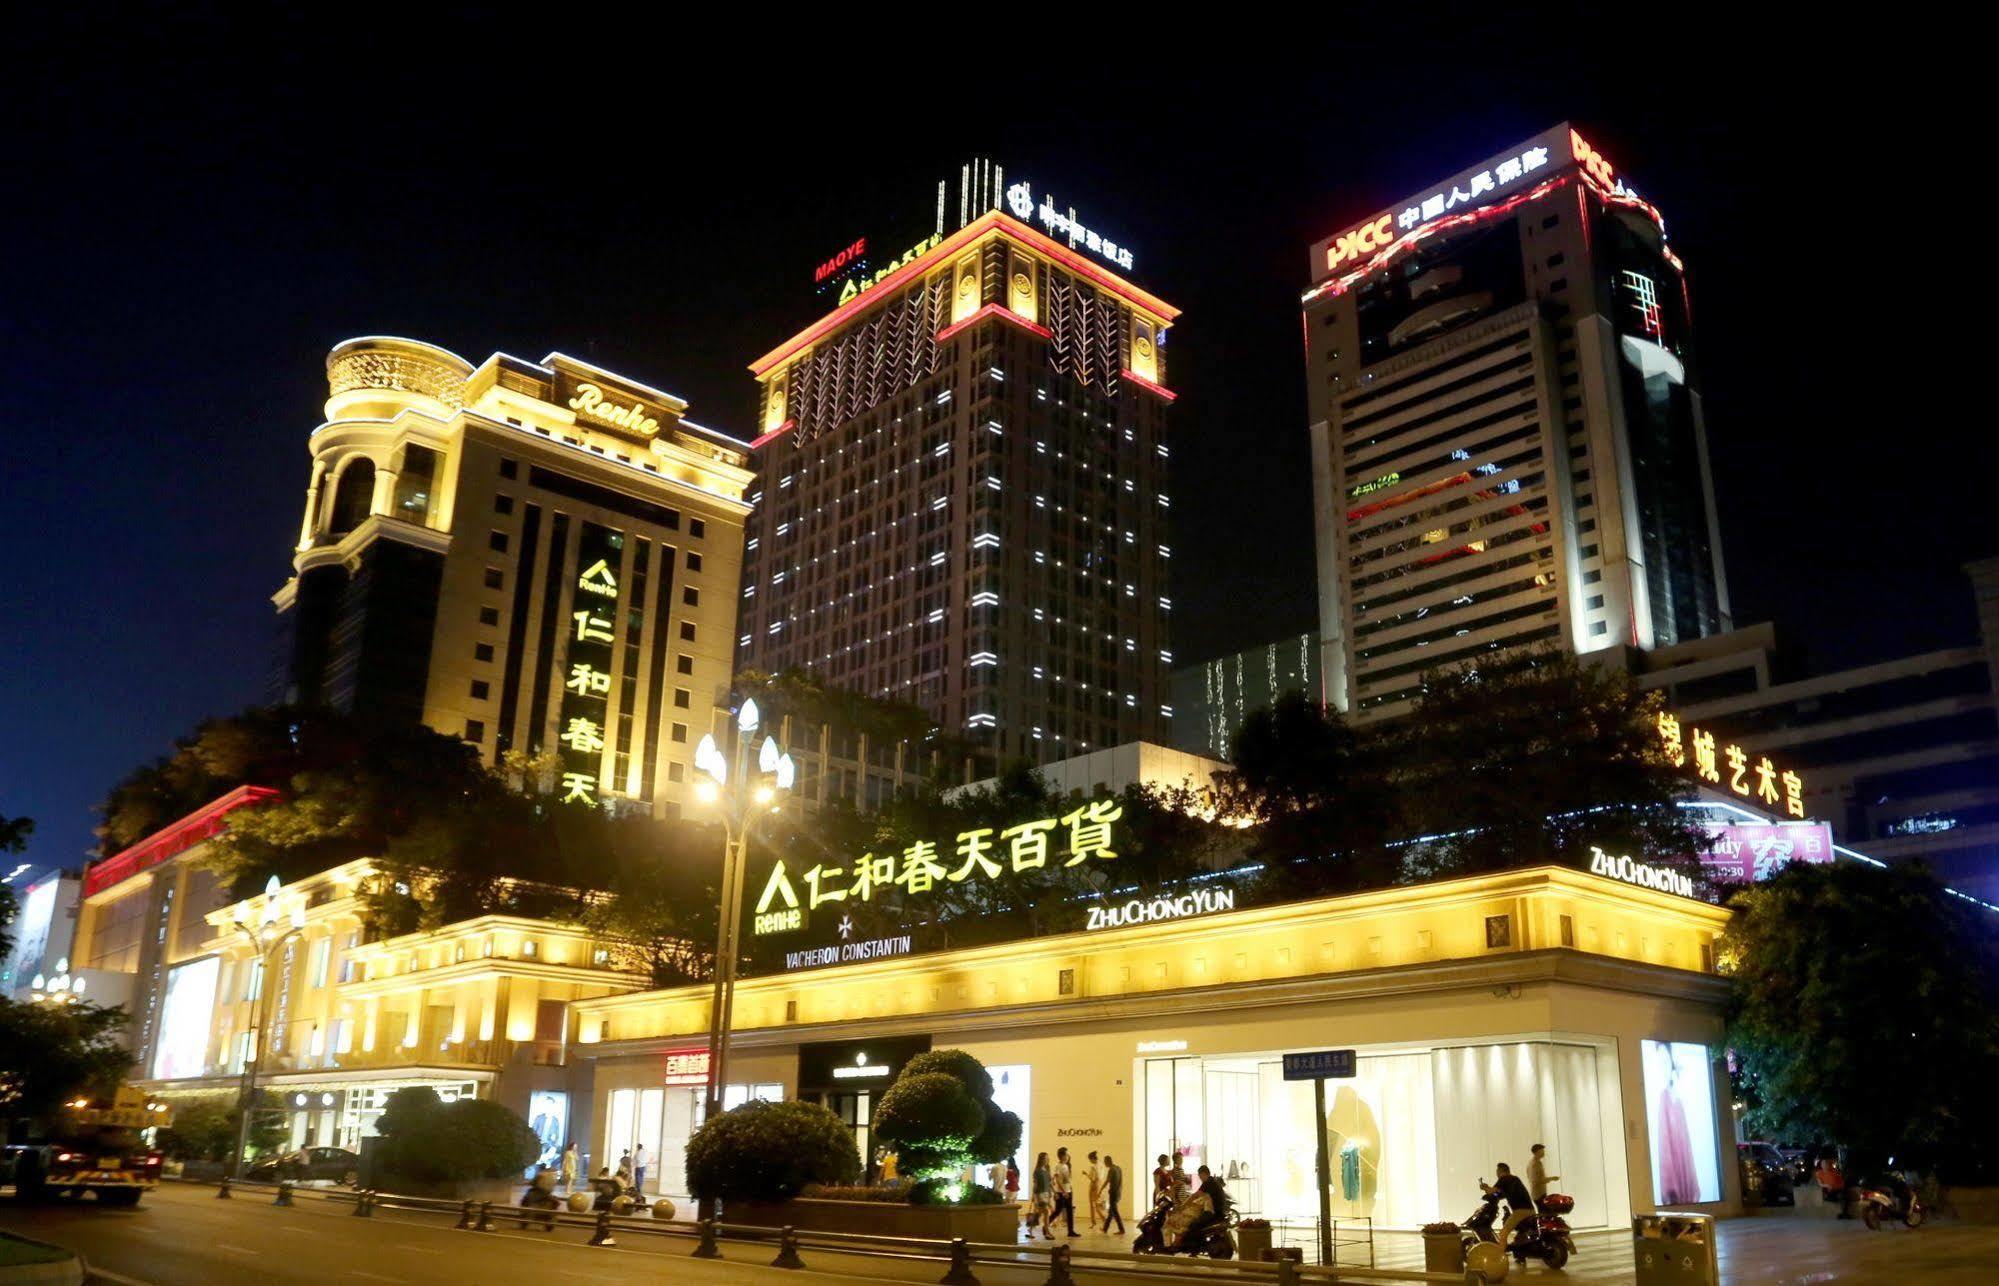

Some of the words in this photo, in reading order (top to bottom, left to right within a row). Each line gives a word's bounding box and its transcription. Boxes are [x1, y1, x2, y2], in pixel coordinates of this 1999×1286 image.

[815, 239, 865, 281] MAOYE
[1327, 214, 1394, 271] PICC
[568, 384, 660, 435] Renhe
[561, 611, 615, 808] 仁和春天
[1086, 888, 1234, 930] ZHUCHONGYUN
[786, 946, 839, 969] VACHERON
[842, 936, 911, 961] CONSTANTIN
